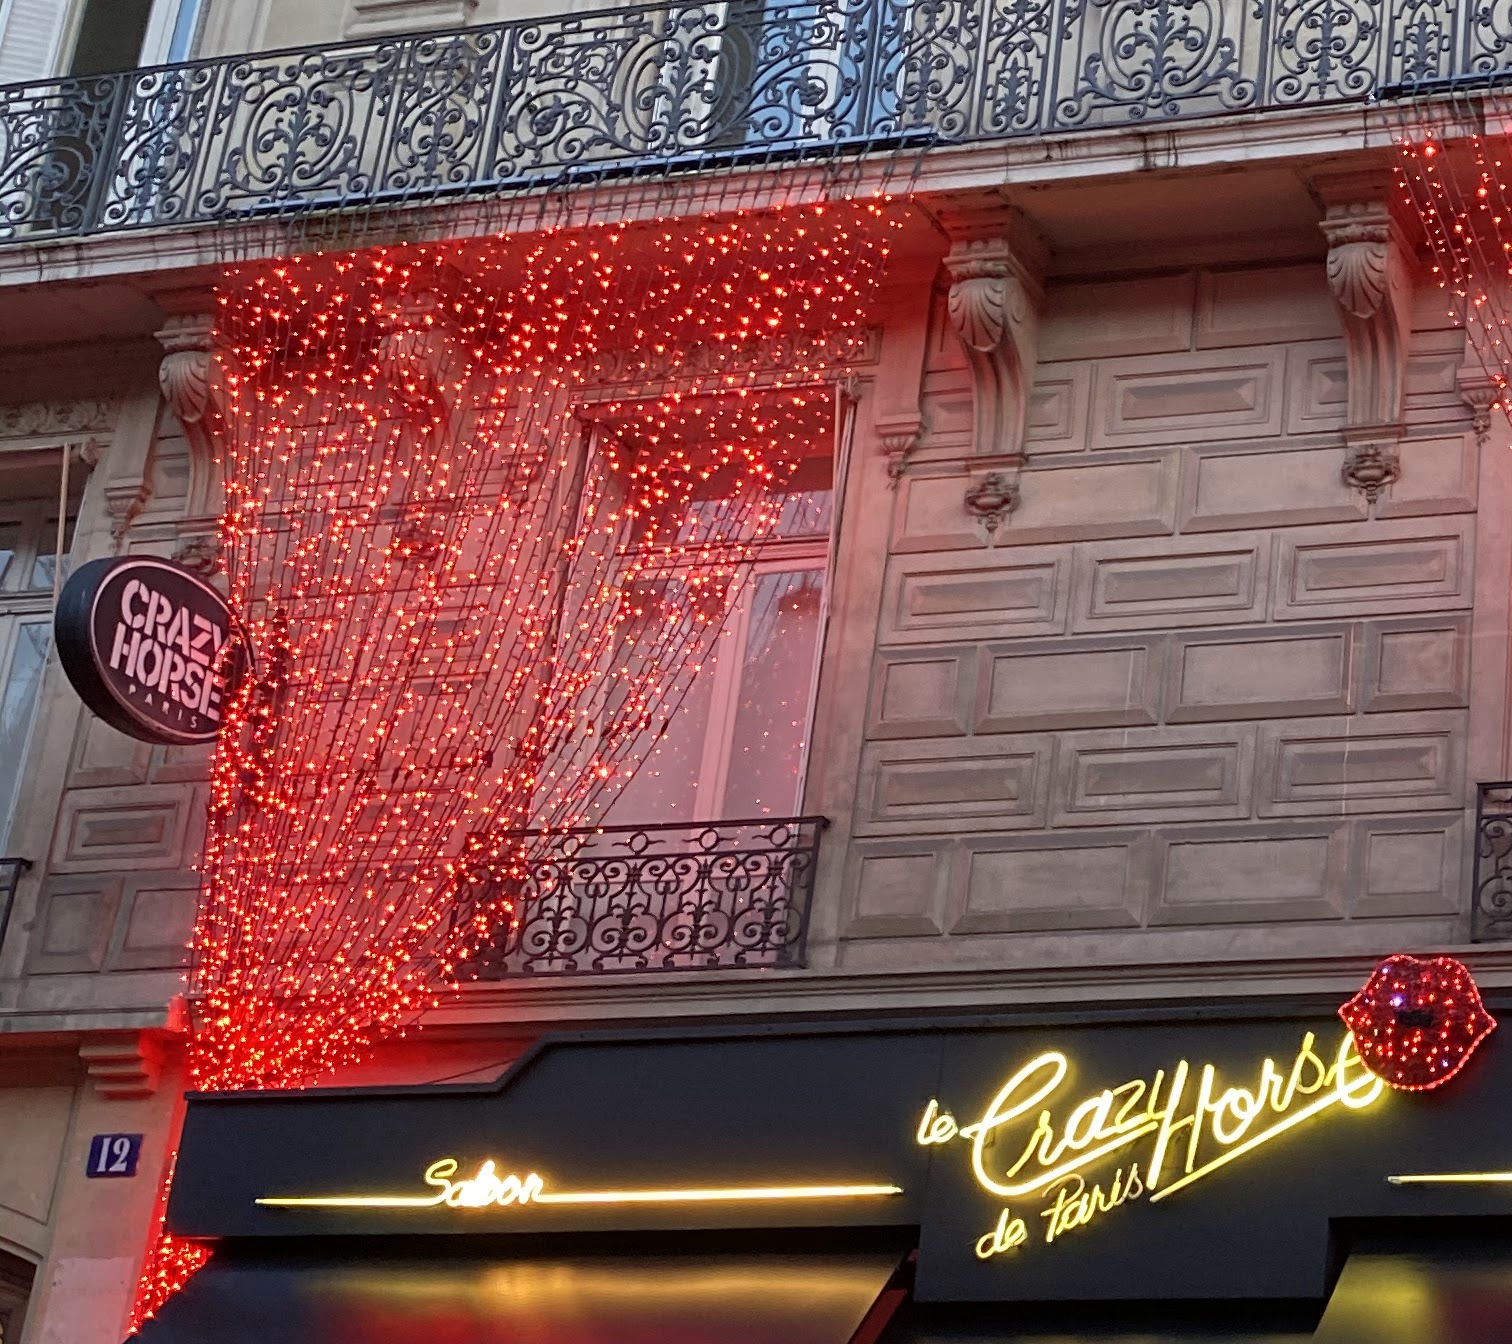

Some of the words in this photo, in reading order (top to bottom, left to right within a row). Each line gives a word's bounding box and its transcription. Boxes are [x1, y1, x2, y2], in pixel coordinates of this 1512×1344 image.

[121, 579, 231, 673] CRAZY
[109, 621, 225, 722] HORSE
[128, 683, 198, 729] PARIS
[96, 1137, 131, 1173] 12
[959, 1051, 1190, 1197] Crazy
[975, 1207, 1028, 1259] de
[1040, 1172, 1144, 1243] Paris
